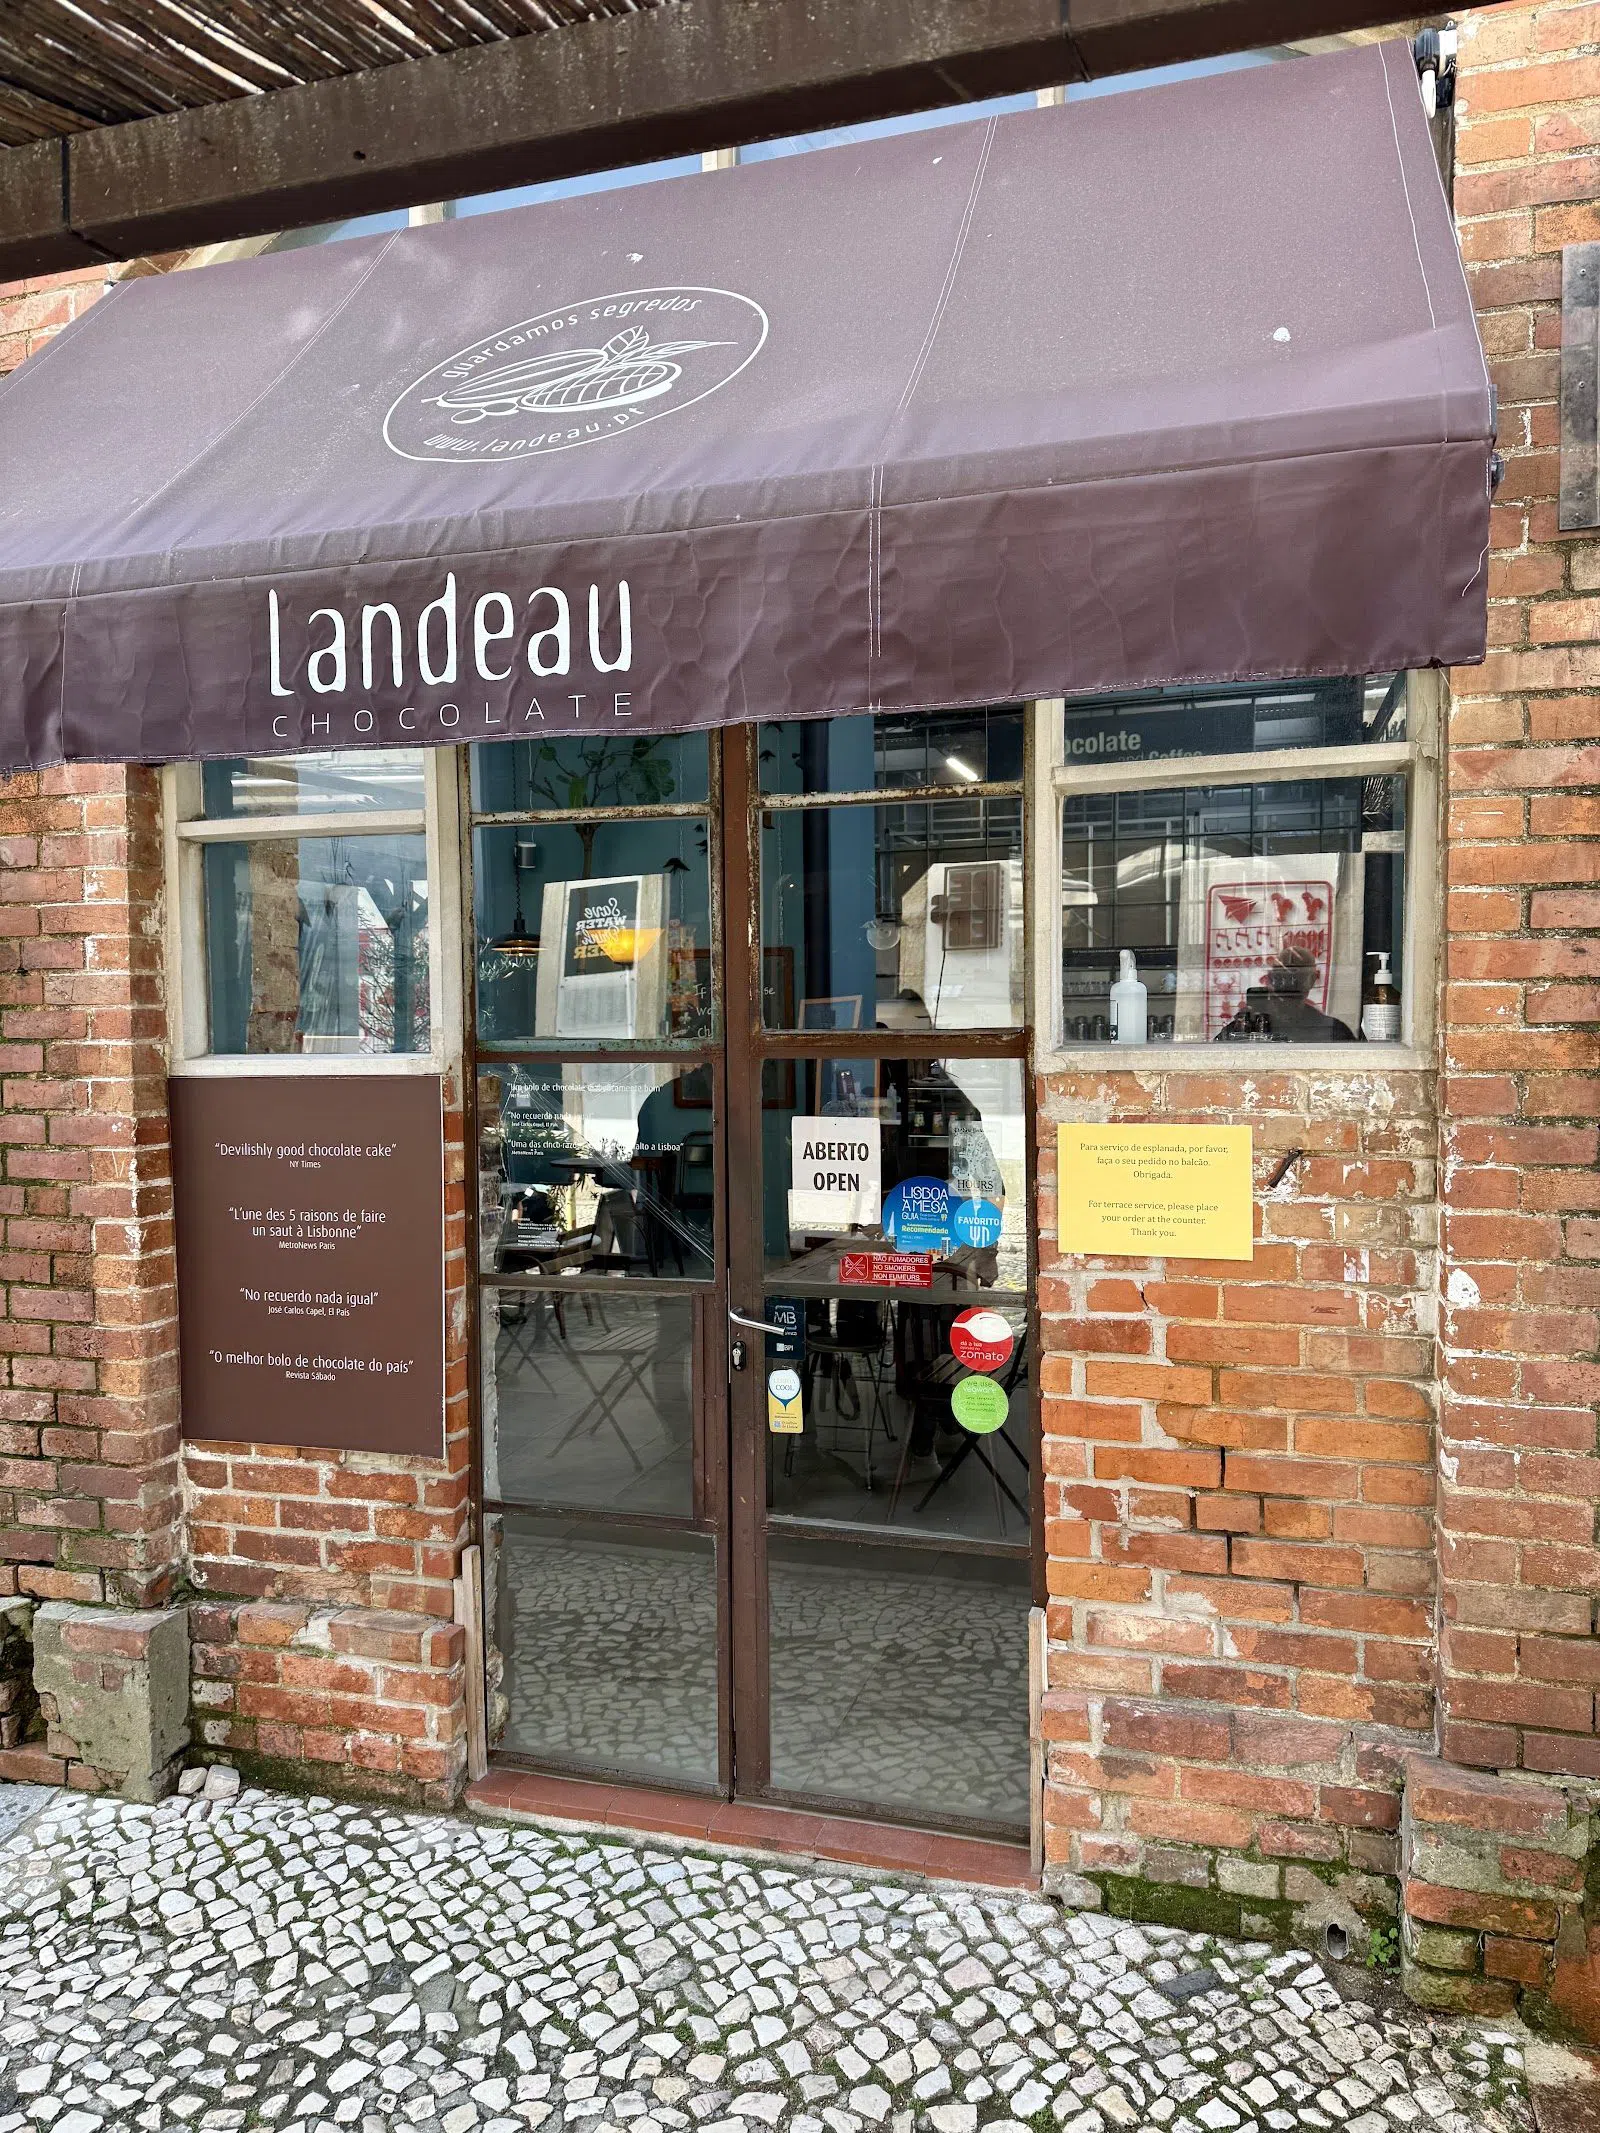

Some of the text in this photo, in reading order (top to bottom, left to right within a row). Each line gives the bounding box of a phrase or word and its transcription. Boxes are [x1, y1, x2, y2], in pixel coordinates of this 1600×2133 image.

[441, 295, 703, 379] guardamos segredos
[423, 406, 646, 453] www.landeau.pt
[268, 571, 633, 697] landeau
[272, 692, 633, 738] CHOCOLATE
[541, 1083, 551, 1091] de
[522, 1112, 553, 1120] recuerdo
[215, 1143, 397, 1159] "Devilishly good chocolate cake"
[529, 1140, 541, 1148] das
[657, 1142, 684, 1151] Lisboa"
[1080, 1143, 1098, 1151] Para
[1099, 1143, 1129, 1152] serviço
[1142, 1144, 1187, 1153] esplanada,
[1188, 1146, 1204, 1154] por
[802, 1141, 869, 1162] ABERTO
[289, 1160, 321, 1168] NY Times
[1097, 1156, 1113, 1165] faça
[1138, 1157, 1167, 1166] pedido
[1133, 1170, 1174, 1180] Obrigada.
[813, 1172, 860, 1192] OPEN
[957, 1179, 994, 1190] HOURS
[902, 1186, 949, 1201] LISBOA
[912, 1200, 949, 1214] MESA
[1088, 1199, 1219, 1212] For terrace service, please place
[266, 1207, 286, 1221] des
[289, 1209, 296, 1221] 5
[300, 1209, 339, 1222] raisons
[343, 1209, 357, 1223] de
[361, 1208, 386, 1223] faire
[901, 1212, 920, 1221] GUIA
[1101, 1215, 1121, 1223] your
[1122, 1214, 1146, 1222] order
[1157, 1215, 1171, 1223] the
[957, 1216, 1000, 1226] FAVORITO
[252, 1225, 362, 1239] un saut à Lisbonne"
[901, 1225, 949, 1235] Recomendado
[1130, 1227, 1177, 1238] Thank you.
[278, 1240, 336, 1250] MetroNews Paris
[888, 1256, 929, 1264] FUMADORES
[240, 1287, 379, 1308] "No recuerdo nada igual"
[268, 1305, 282, 1315] José
[284, 1306, 304, 1315] Carlos
[305, 1306, 327, 1317] Capel,
[328, 1307, 335, 1316] El
[774, 1311, 797, 1325] MB
[960, 1350, 1004, 1361] zomato
[209, 1349, 414, 1375] "O melhor bolo de chocolate do país"
[285, 1370, 336, 1381] Revista Sábado
